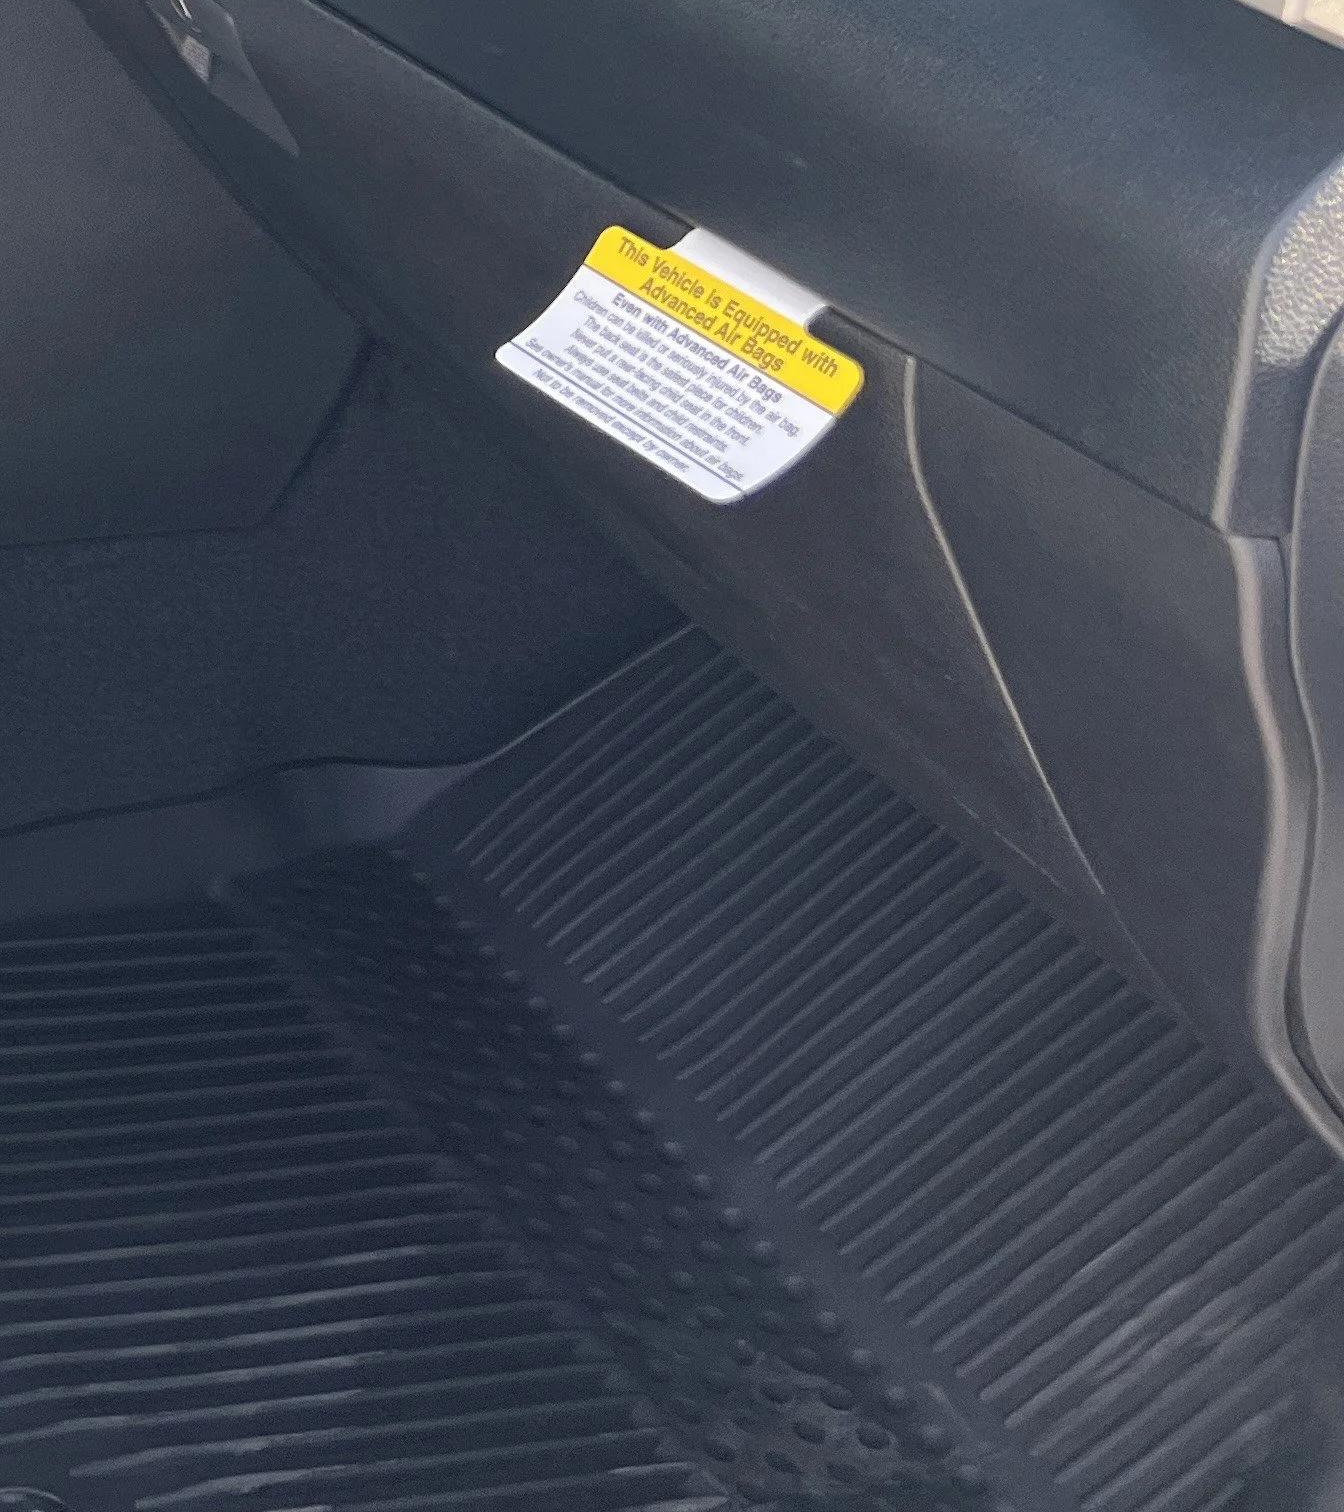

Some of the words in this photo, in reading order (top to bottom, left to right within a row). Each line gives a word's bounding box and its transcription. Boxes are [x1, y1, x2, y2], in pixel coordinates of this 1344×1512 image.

[573, 290, 608, 316] Children
[606, 312, 624, 327] can
[622, 320, 636, 334] be
[656, 343, 670, 354] or
[667, 350, 707, 379] seriously
[705, 373, 740, 397] injured
[734, 390, 751, 406] by
[749, 399, 766, 415] the
[764, 410, 781, 423] air
[611, 292, 642, 317] Even
[642, 313, 668, 333] with
[667, 328, 729, 369] Advanced
[726, 363, 749, 381] Air
[747, 375, 782, 403] Bags
[618, 236, 649, 266] This
[652, 256, 704, 298] Vehicle
[723, 300, 801, 354] Equipped
[801, 347, 837, 377] with
[639, 277, 716, 330] Advanced
[713, 322, 741, 345] Air
[740, 336, 783, 371] Bags
[583, 315, 601, 332] The
[598, 326, 620, 345] back
[636, 350, 648, 362] is
[645, 356, 662, 371] the
[710, 396, 728, 410] for
[592, 344, 612, 358] put
[709, 416, 727, 431] the
